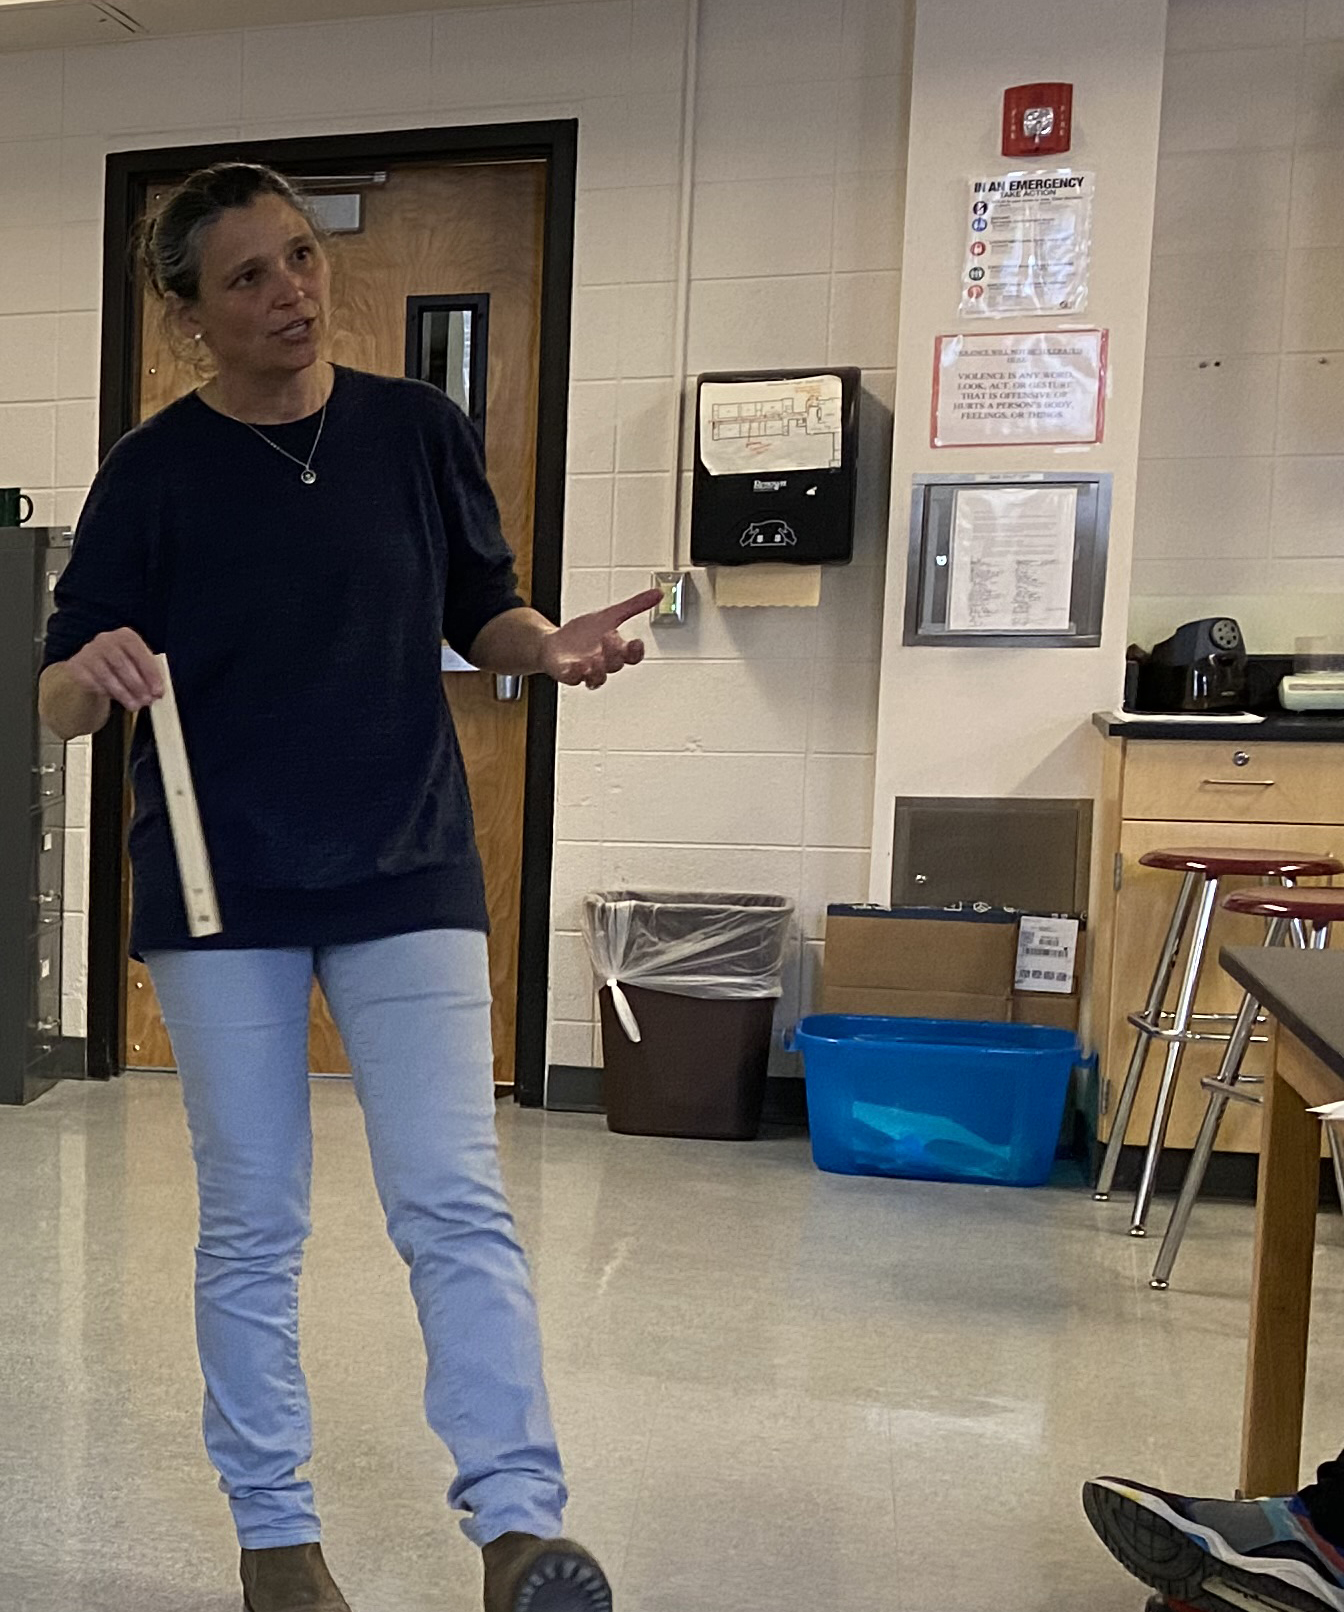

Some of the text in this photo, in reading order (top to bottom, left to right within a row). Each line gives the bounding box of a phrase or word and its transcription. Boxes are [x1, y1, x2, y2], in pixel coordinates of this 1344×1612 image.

[974, 177, 1085, 193] IN AN EMERGENCY
[1000, 189, 1056, 198] TAKE ACTION
